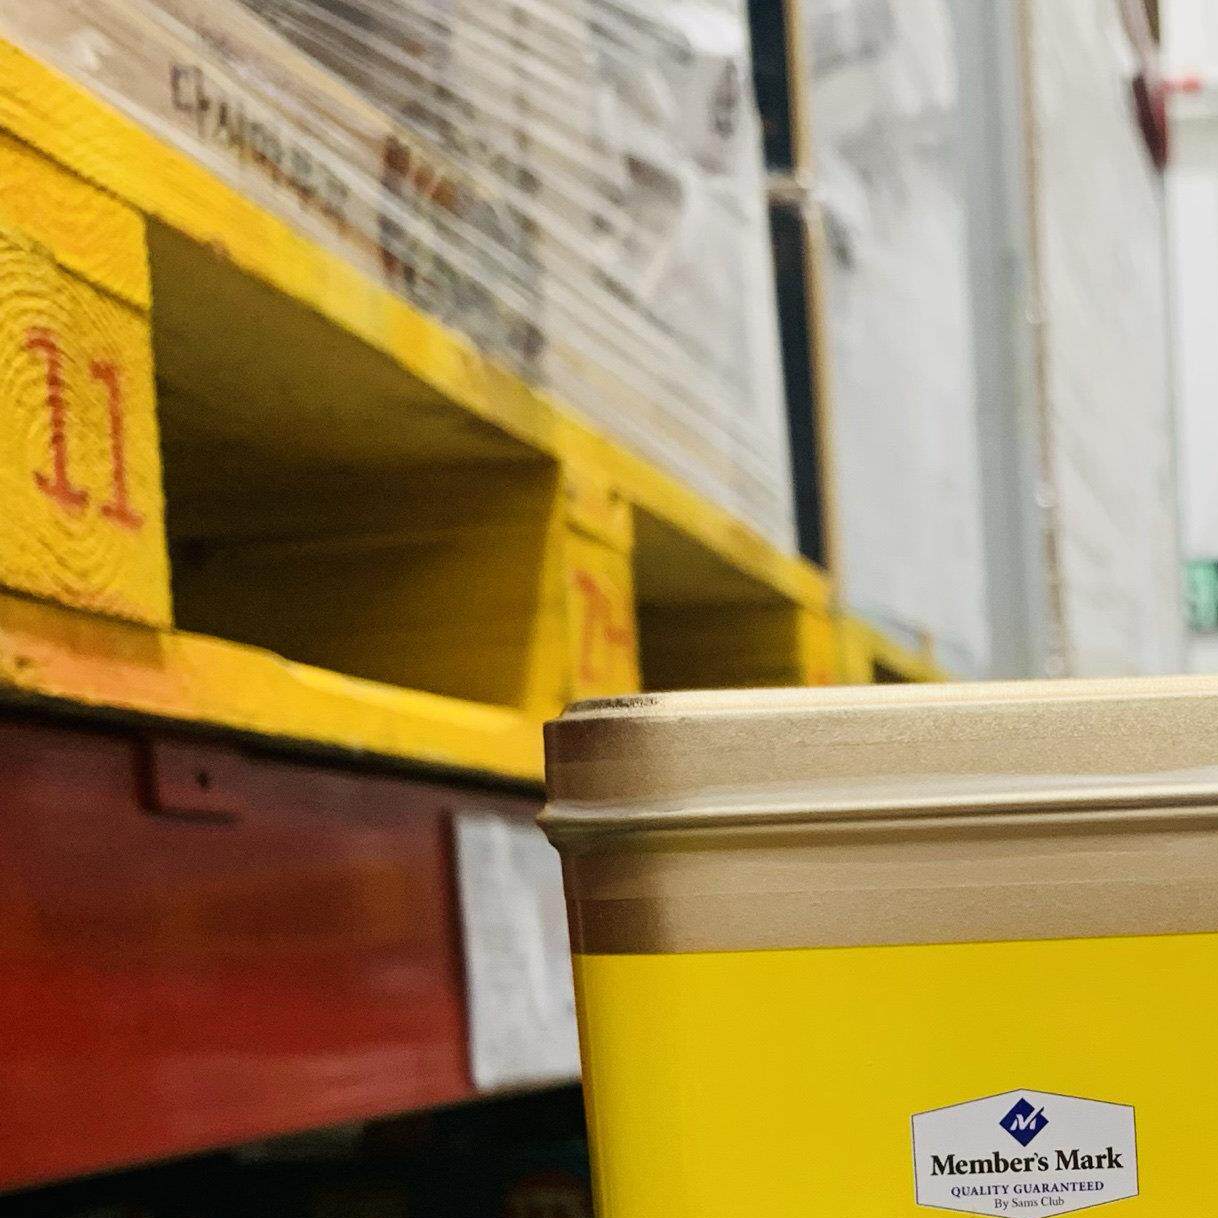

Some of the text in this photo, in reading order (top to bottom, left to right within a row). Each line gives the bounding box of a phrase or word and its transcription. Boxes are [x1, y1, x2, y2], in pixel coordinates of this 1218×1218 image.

[931, 1147, 1123, 1175] Member's Mark
[951, 1182, 1104, 1197] QUALITY GUARANTEED
[994, 1198, 1010, 1210] By
[1041, 1196, 1065, 1207] Club
